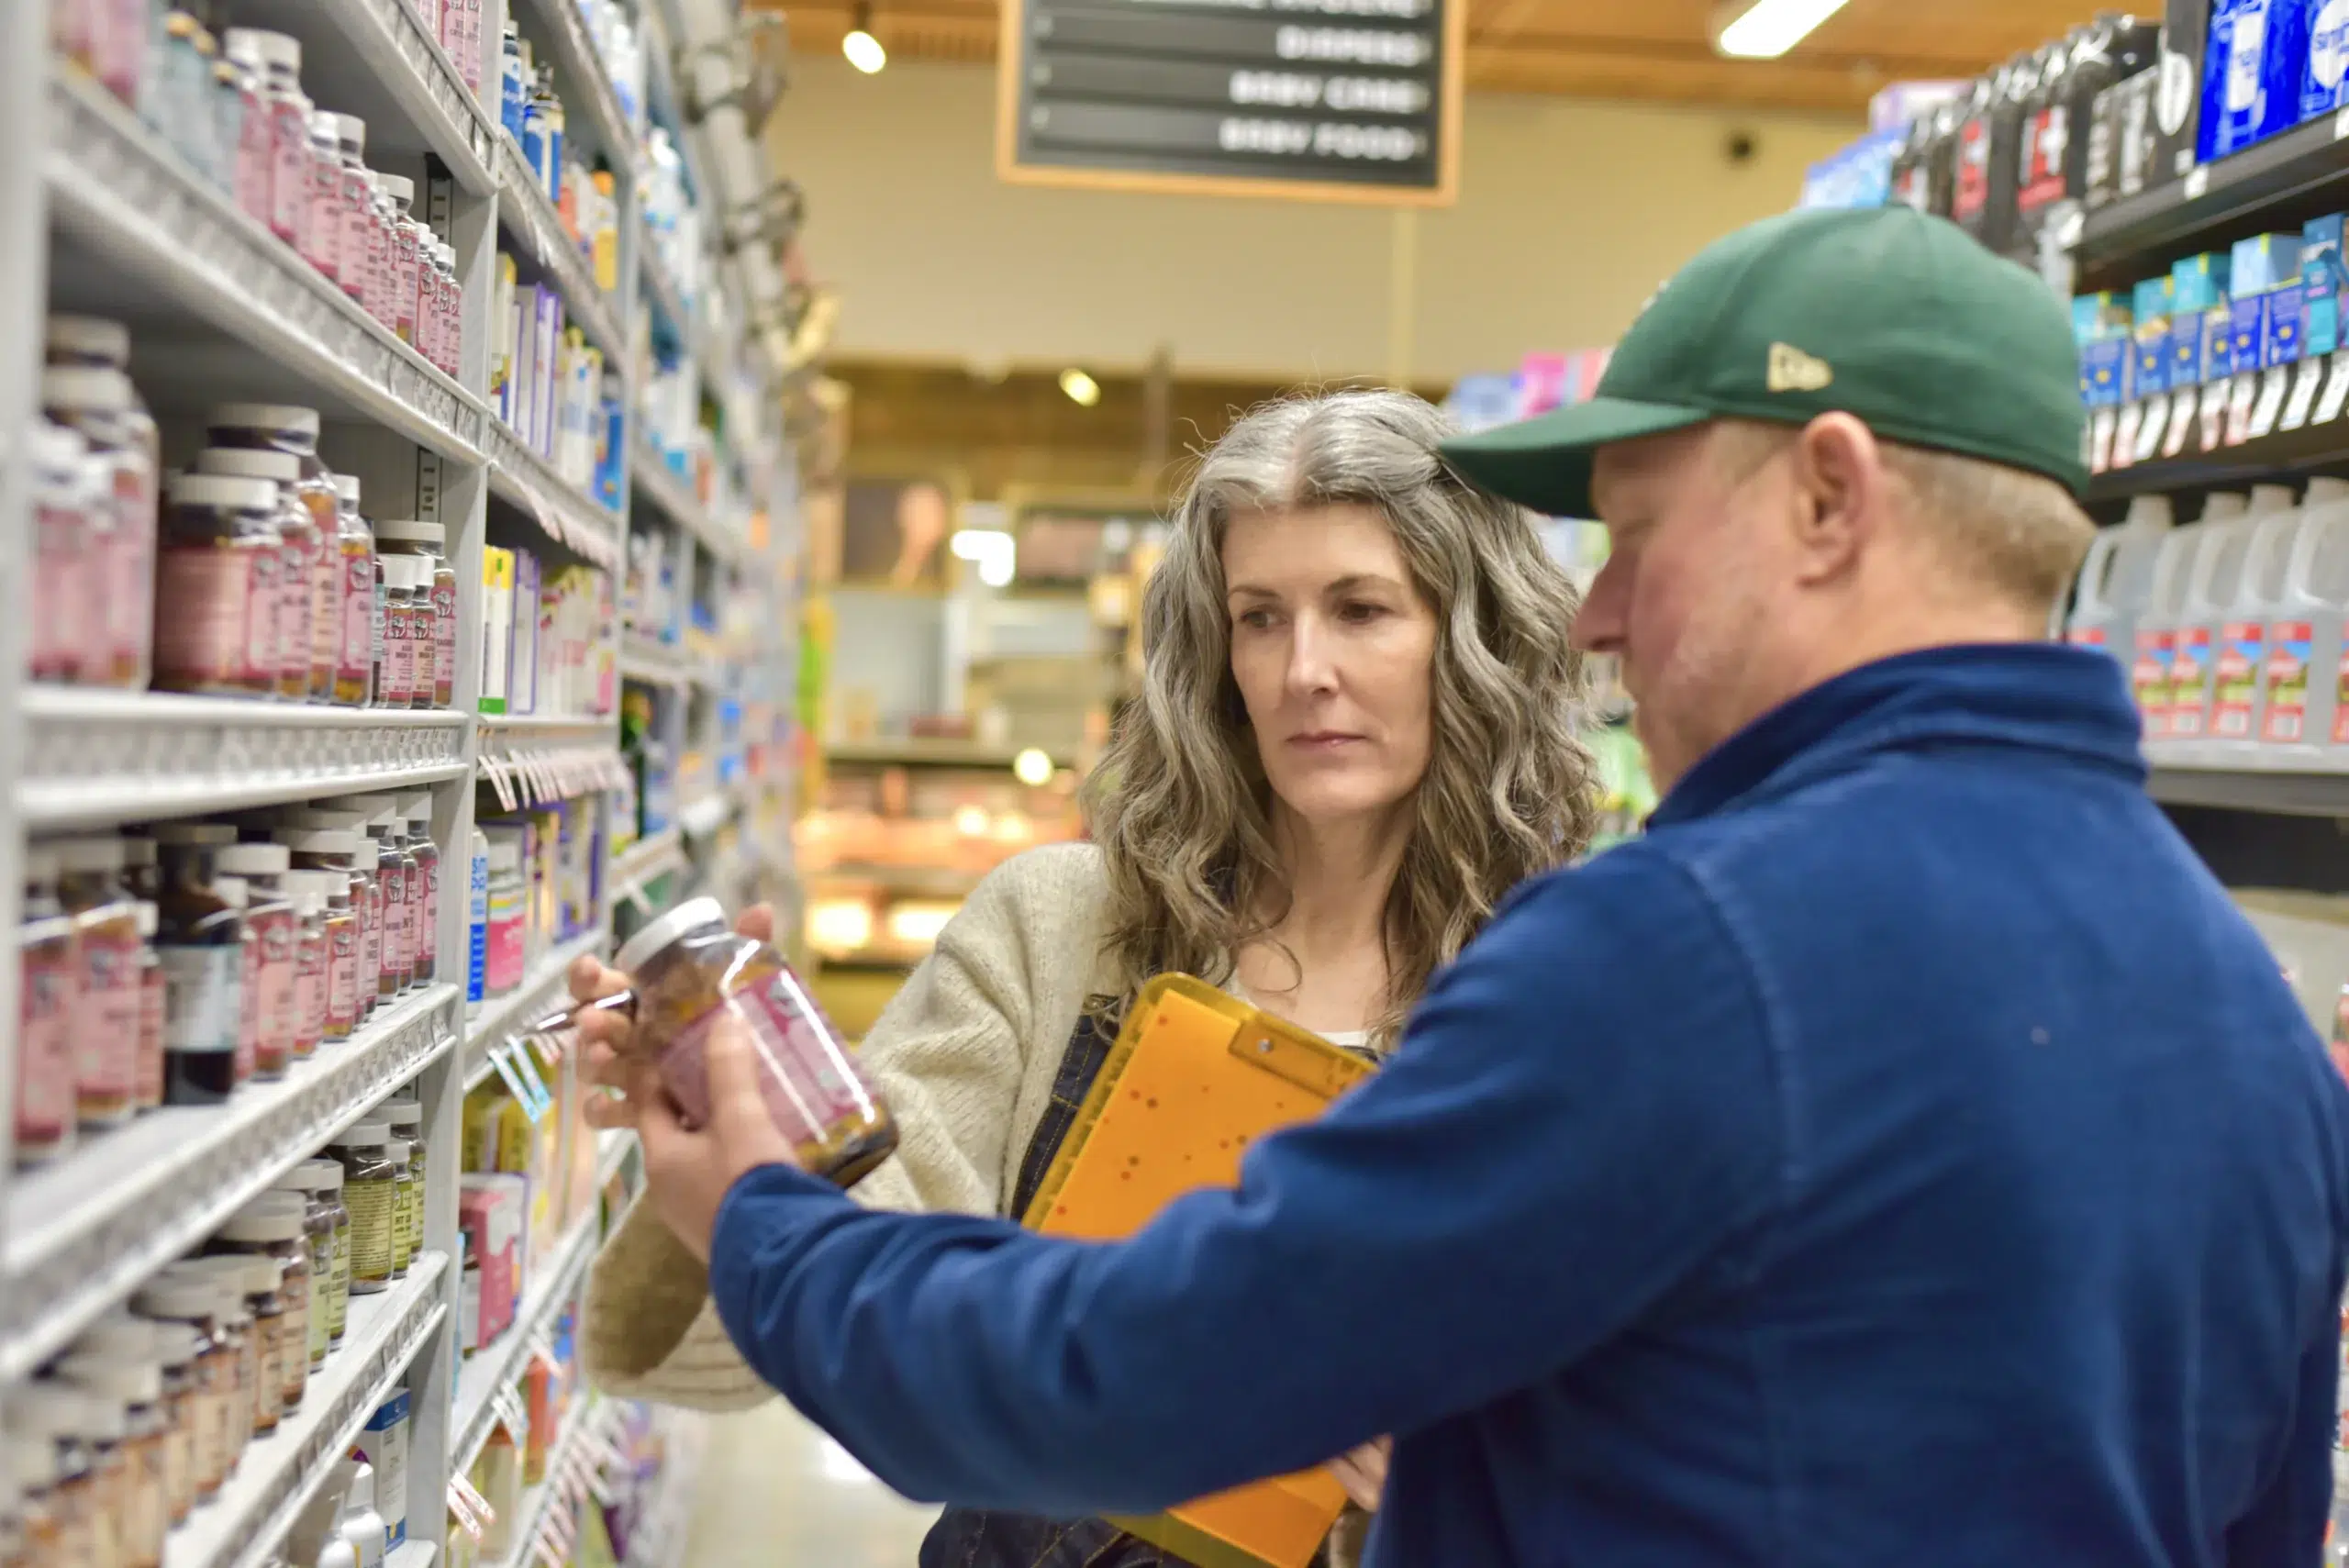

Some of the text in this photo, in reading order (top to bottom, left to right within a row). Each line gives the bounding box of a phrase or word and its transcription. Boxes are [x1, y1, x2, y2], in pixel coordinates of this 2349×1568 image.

[1275, 25, 1428, 66] DIAPERS
[1230, 71, 1425, 113] BABY CARE
[1219, 117, 1419, 161] BABY FOOD
